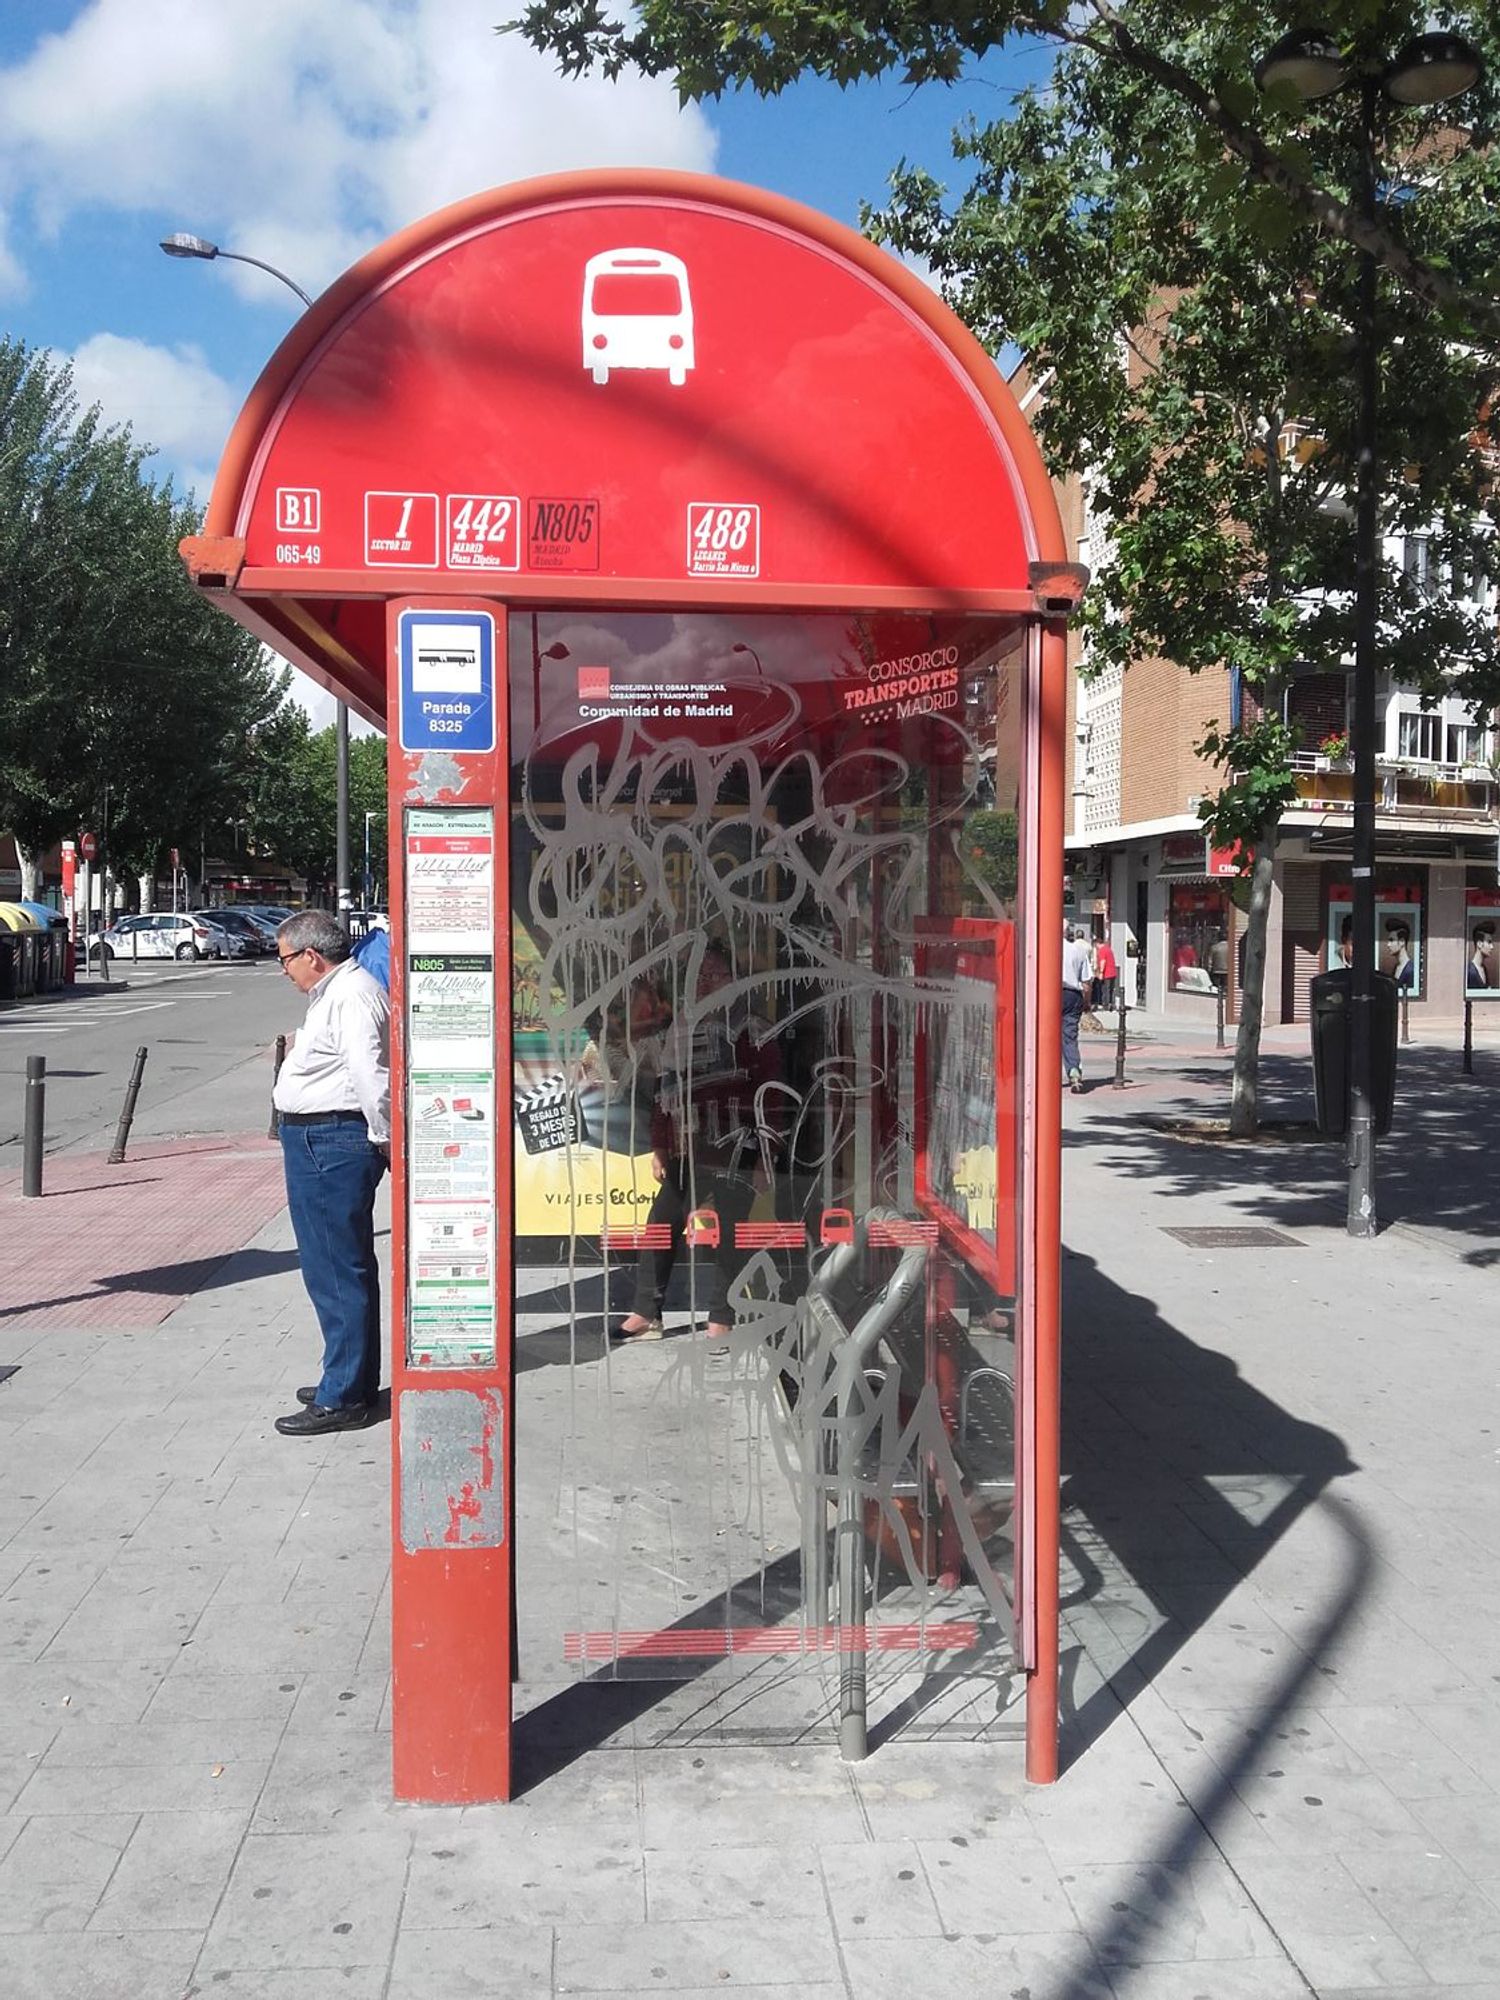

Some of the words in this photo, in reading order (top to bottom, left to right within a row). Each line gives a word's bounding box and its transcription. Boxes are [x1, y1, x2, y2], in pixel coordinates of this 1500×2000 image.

[285, 494, 312, 526] B1
[396, 498, 413, 538] 1
[453, 499, 512, 543] 442
[531, 503, 595, 543] N805
[694, 508, 752, 551] 488
[276, 544, 320, 565] 065-49
[452, 542, 484, 553] MADRID
[534, 545, 571, 554] MADRID
[868, 646, 958, 682] CONSORCIO
[654, 683, 664, 691] DE
[665, 683, 689, 691] OBRAS
[844, 667, 958, 710] TRANSPORTES
[659, 692, 709, 700] TRANSPORTES
[422, 700, 471, 715] Parada
[579, 704, 660, 717] Comunidad
[663, 704, 681, 717] de
[685, 703, 734, 717] Madrid
[896, 690, 958, 719] MADRID
[428, 720, 463, 733] 8325
[414, 841, 421, 852] 1
[413, 959, 445, 971] N805
[529, 1107, 560, 1124] REGALO
[530, 1124, 539, 1137] 3
[539, 1137, 550, 1149] DE
[545, 1193, 604, 1207] VIAJES
